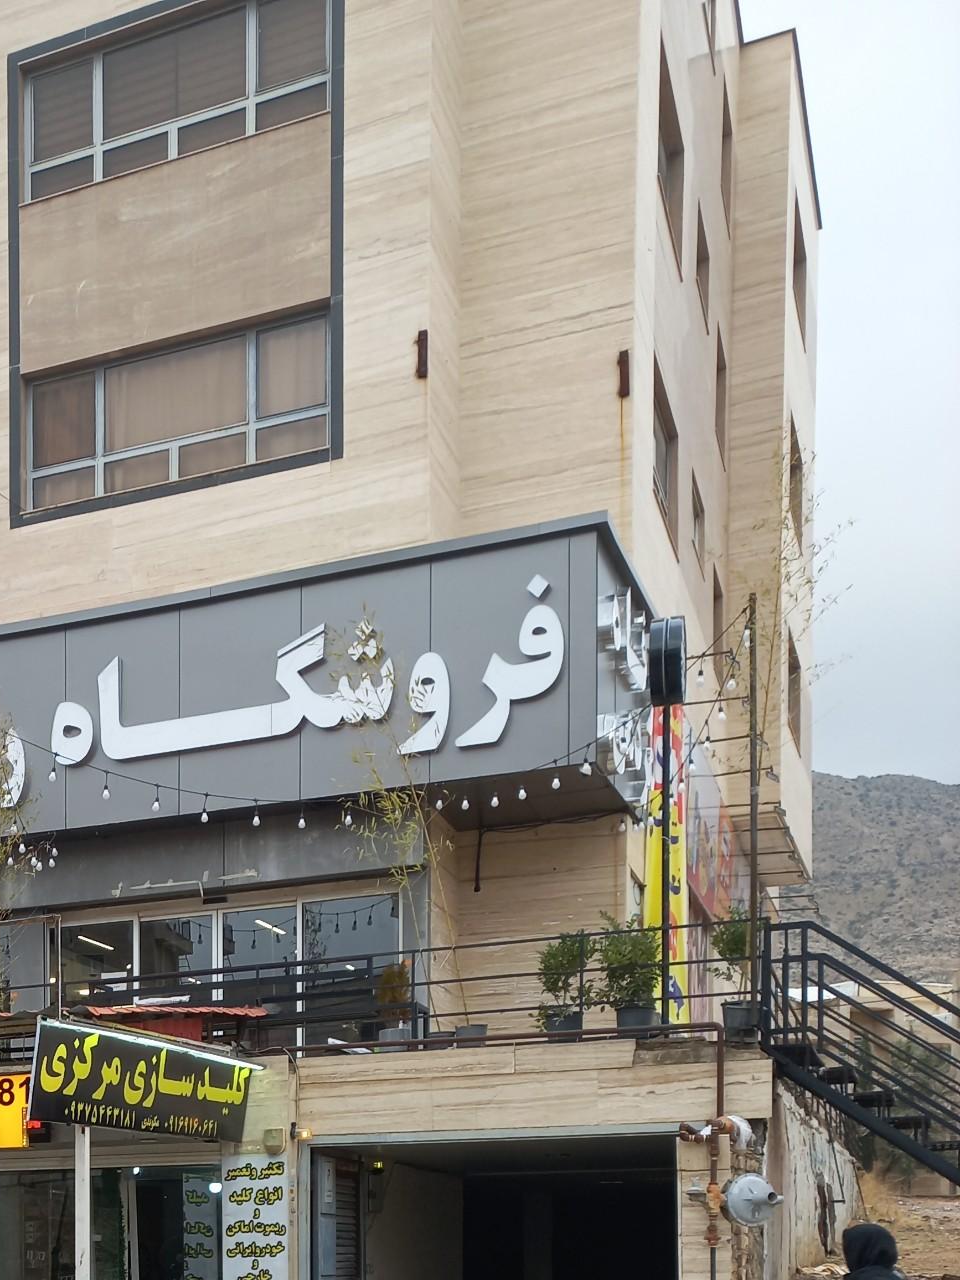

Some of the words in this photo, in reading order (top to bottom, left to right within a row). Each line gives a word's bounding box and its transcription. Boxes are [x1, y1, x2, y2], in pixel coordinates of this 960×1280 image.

[50, 573, 565, 767] فروشگاه
[40, 1033, 122, 1100] مرکزی
[123, 1048, 195, 1107] سازی
[197, 1064, 253, 1116] کلید
[258, 1161, 285, 1180] تکثیر
[229, 1187, 253, 1206] کلید
[254, 1186, 283, 1205] انواع
[226, 1219, 254, 1237] اماکن
[255, 1222, 286, 1236] ریموت
